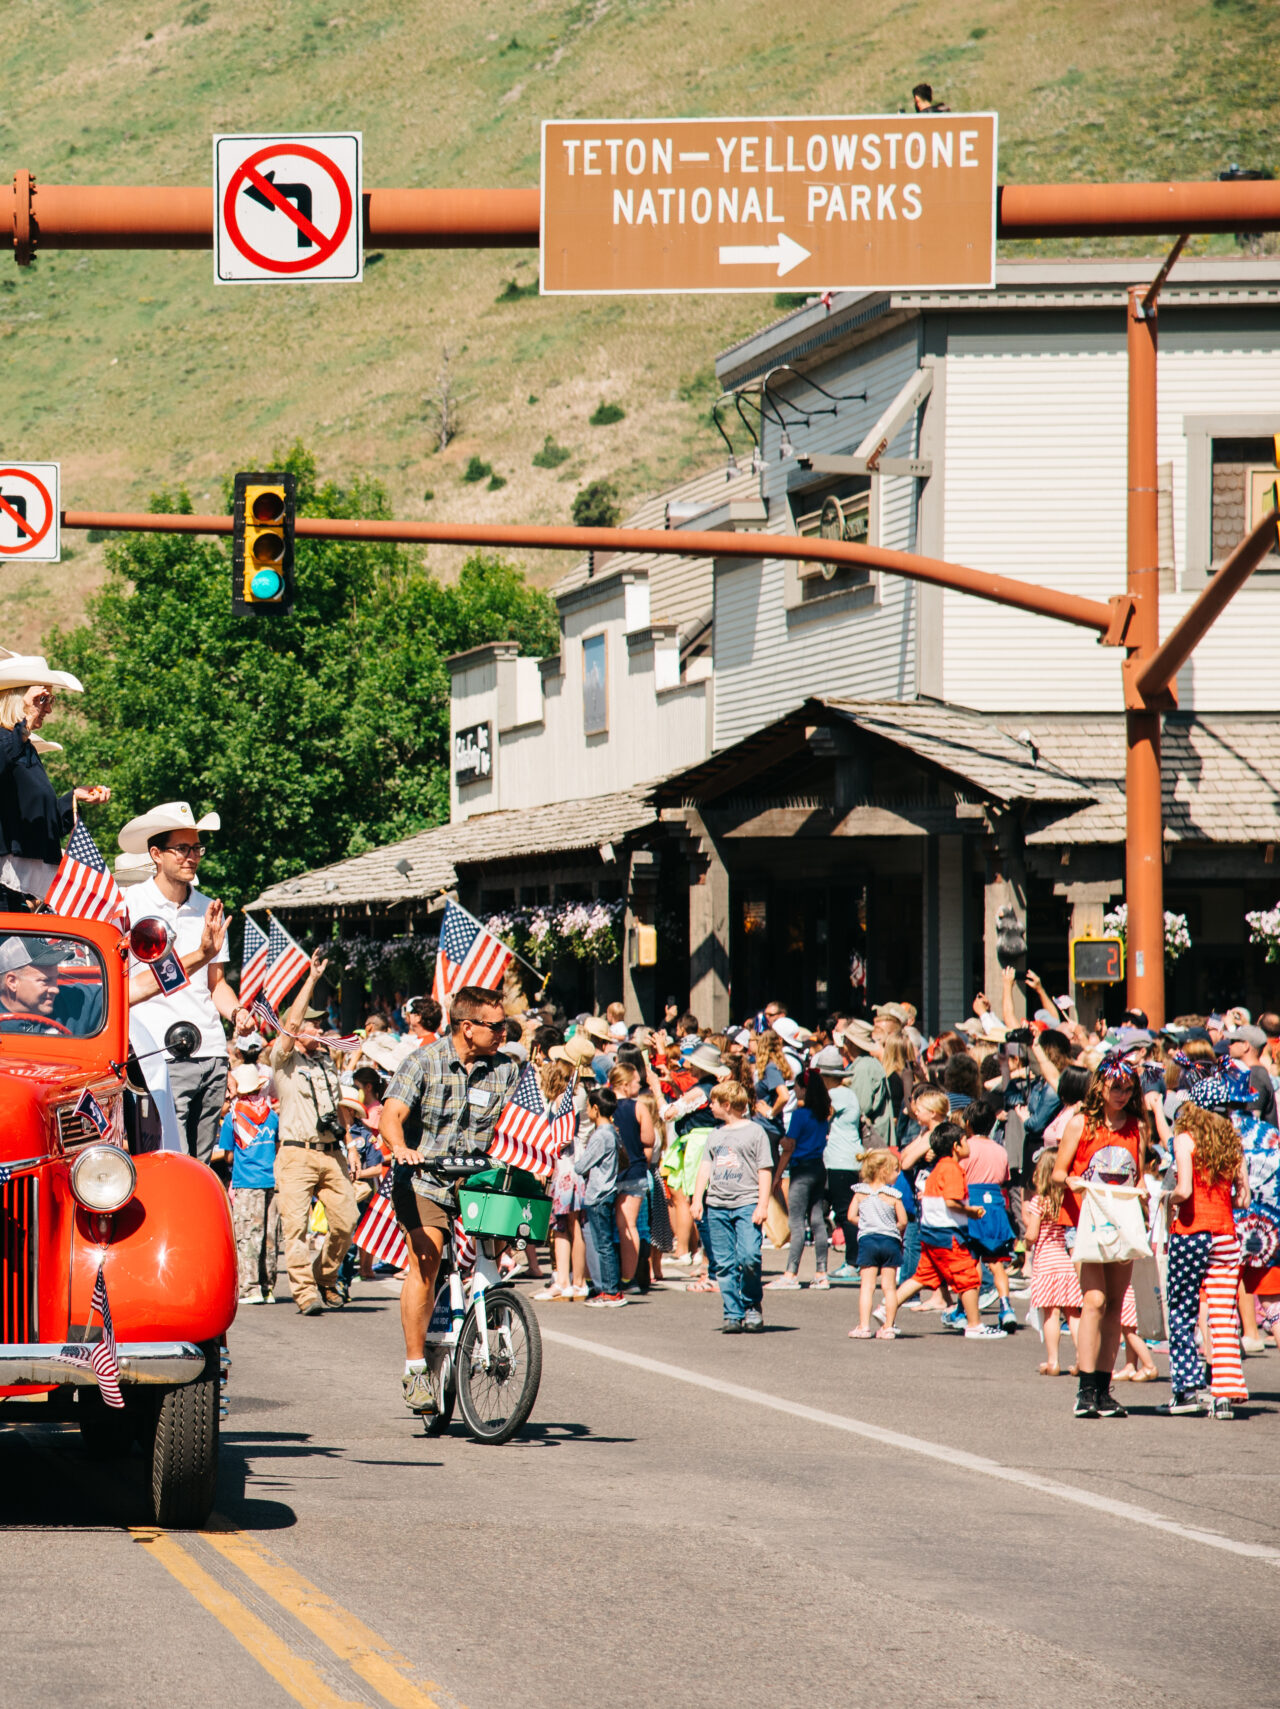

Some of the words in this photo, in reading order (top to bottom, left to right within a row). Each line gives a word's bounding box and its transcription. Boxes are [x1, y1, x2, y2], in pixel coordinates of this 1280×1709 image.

[613, 187, 785, 225] NATIONAL
[807, 183, 922, 222] PARKS
[1106, 946, 1118, 975] 2
